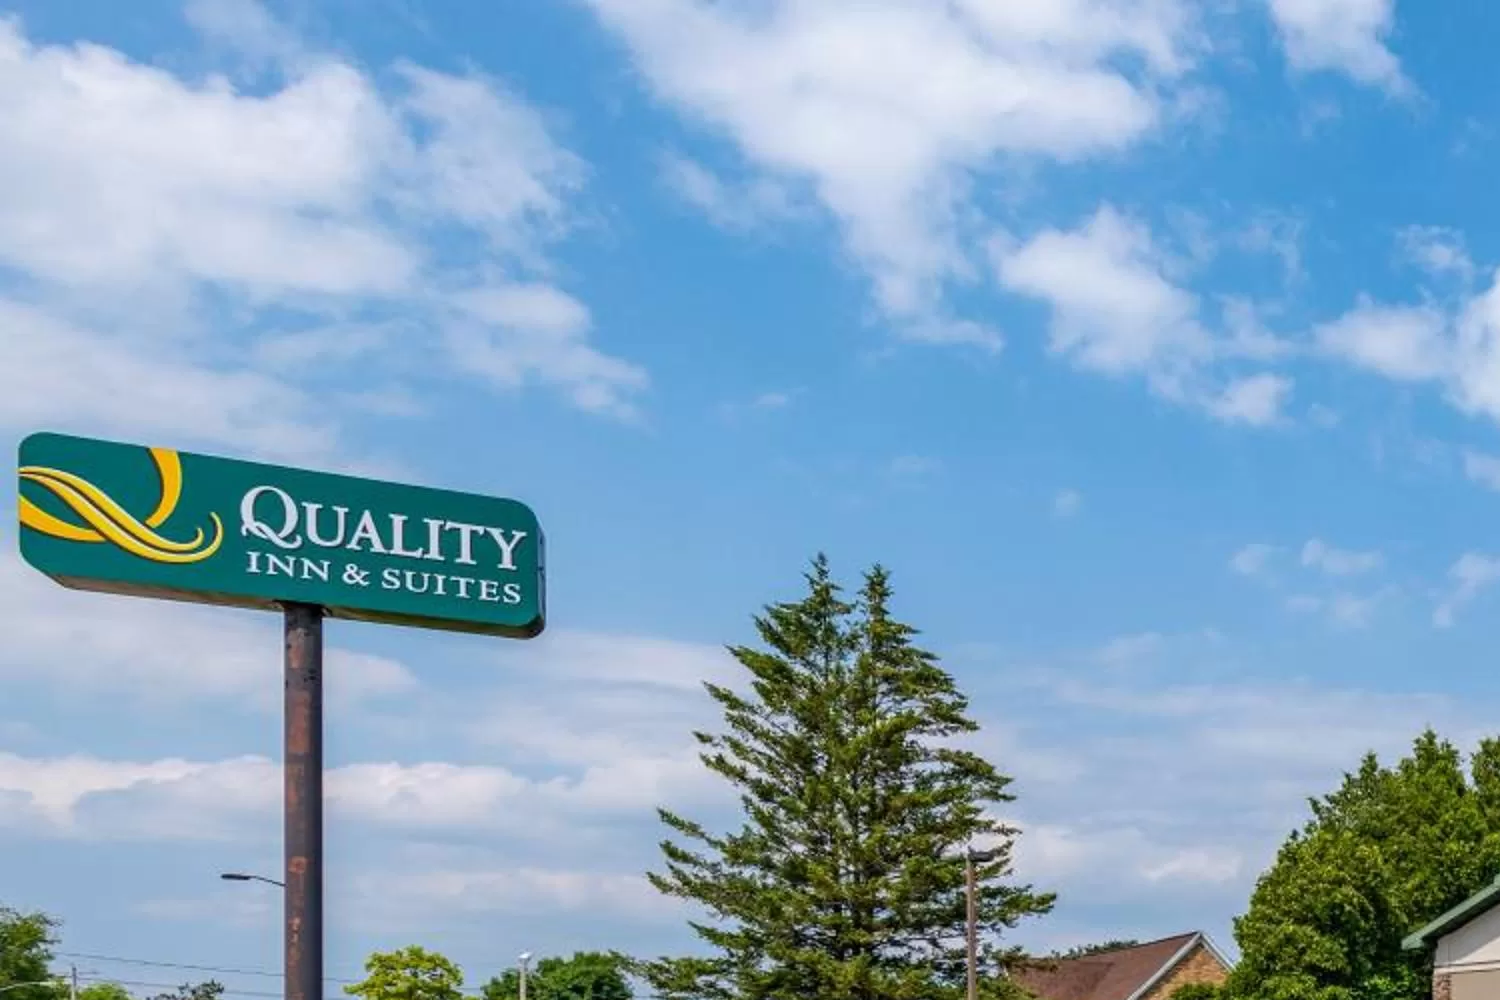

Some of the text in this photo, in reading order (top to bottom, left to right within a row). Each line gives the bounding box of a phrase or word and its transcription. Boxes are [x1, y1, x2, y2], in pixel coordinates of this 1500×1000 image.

[240, 485, 527, 570] QUALITY
[246, 551, 521, 604] INN & SUITES
